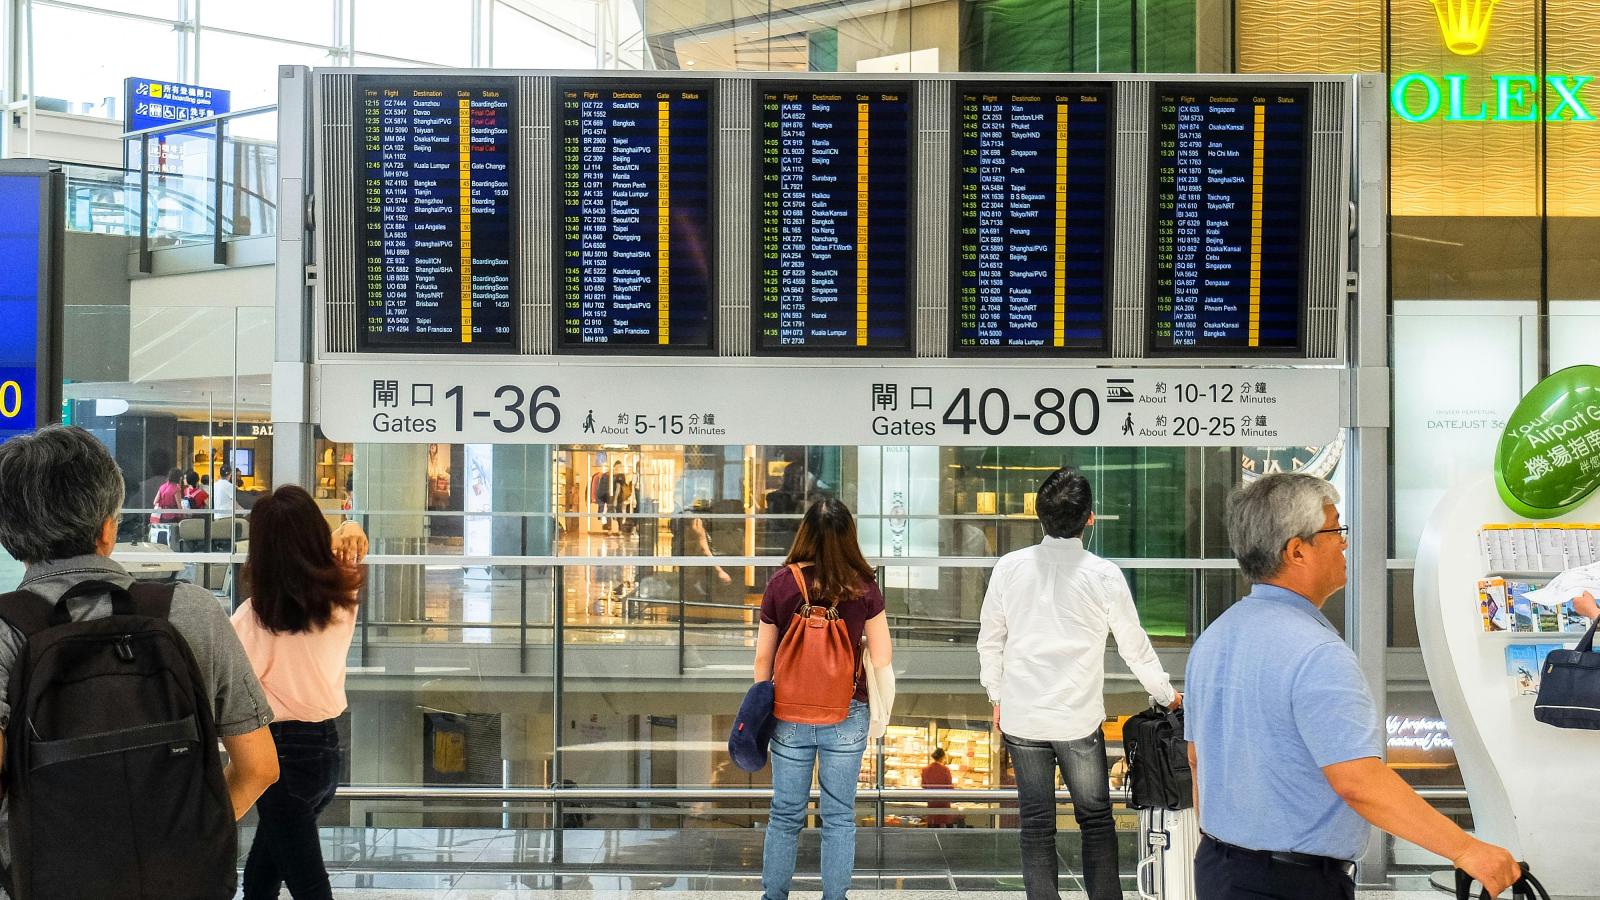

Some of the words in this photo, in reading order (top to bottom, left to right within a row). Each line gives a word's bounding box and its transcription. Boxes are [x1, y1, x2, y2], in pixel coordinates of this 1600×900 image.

[172, 94, 195, 103] boarding
[384, 90, 399, 98] Flight
[583, 92, 599, 100] Flight
[656, 92, 670, 100] Gate
[783, 94, 798, 102] Flight
[982, 95, 998, 103] Flight
[1180, 96, 1195, 104] Flight
[413, 100, 441, 108] Quanzhou
[471, 101, 508, 109] BoardingSoon
[612, 102, 639, 110] Seoul/ICN
[812, 104, 830, 112] Beijing
[1209, 106, 1235, 114] Singapore
[1011, 114, 1044, 122] London/LHR
[366, 188, 381, 196] 12:50
[385, 188, 394, 196] KA
[394, 188, 407, 196] 1104
[414, 188, 431, 197] Tianjin
[425, 224, 446, 232] Angeles
[820, 227, 835, 235] Nang
[416, 292, 444, 300] Tokyo/NRT
[472, 292, 509, 301] BoardingSoon
[827, 329, 847, 337] Lumpur
[1155, 381, 1167, 394] 約
[1240, 381, 1267, 394] 分鐘
[373, 380, 434, 408] 閘口
[872, 383, 932, 411] 閘口
[1138, 394, 1167, 404] About
[1174, 383, 1233, 403] 10-12
[1239, 394, 1277, 404] Minutes
[373, 412, 437, 433] Gates
[445, 385, 561, 433] 1-36
[872, 416, 936, 436] Gates
[942, 387, 1100, 436] 40-80
[617, 412, 629, 425] 約
[688, 412, 716, 426] 分鐘
[1155, 414, 1167, 427] 約
[1240, 414, 1267, 427] 分鐘
[600, 427, 629, 435] About
[635, 414, 684, 435] 5-15
[1138, 428, 1167, 437] About
[1172, 416, 1235, 436] 20-25
[1427, 420, 1487, 429] DATEJUST
[1491, 420, 1506, 429] 36
[688, 426, 726, 436] Minutes
[1241, 428, 1278, 437] Minutes
[1526, 410, 1589, 449] Airport
